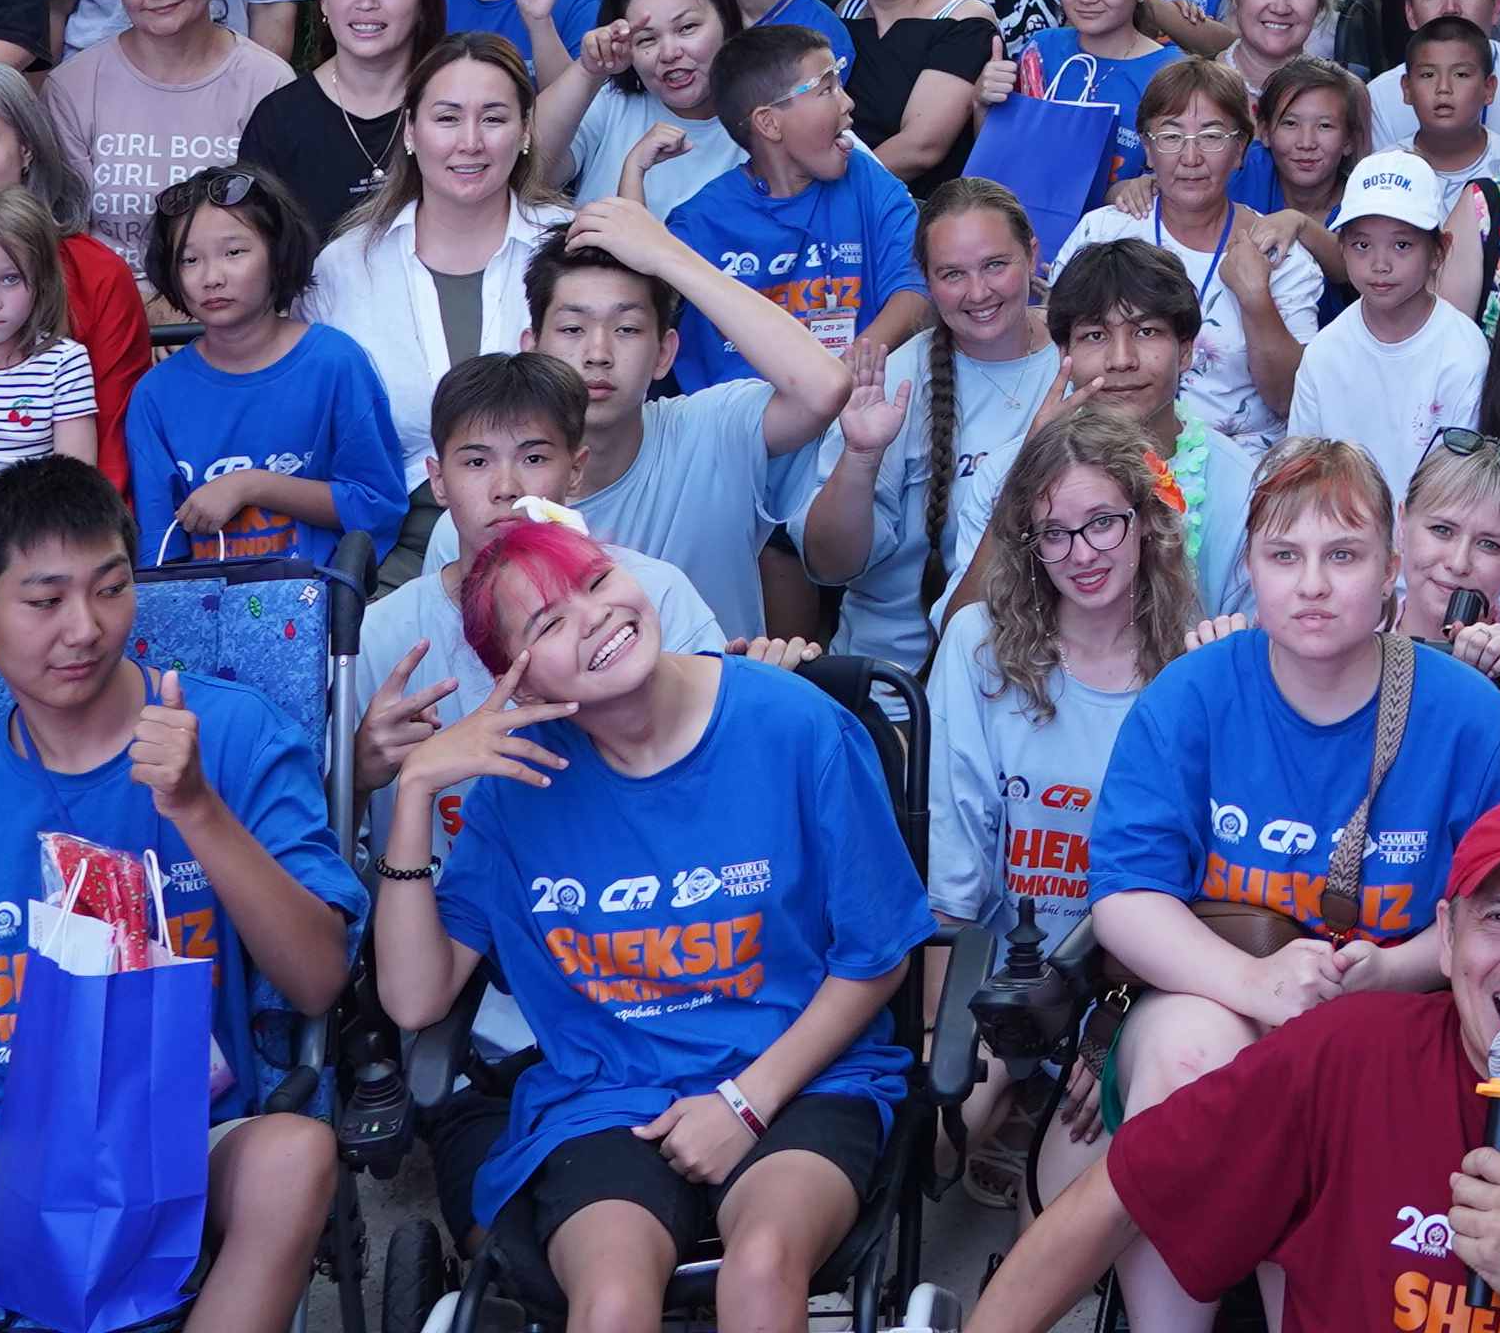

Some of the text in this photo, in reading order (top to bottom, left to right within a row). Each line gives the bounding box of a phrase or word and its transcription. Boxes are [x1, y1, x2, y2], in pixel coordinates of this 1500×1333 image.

[96, 133, 240, 158] GIRL BOSS
[94, 163, 159, 186] GIRL
[720, 252, 759, 276] 20
[1379, 832, 1427, 845] SAMRUK
[1384, 851, 1421, 865] TRUST
[720, 860, 770, 880] SAMRUK
[533, 877, 585, 913] 20
[726, 881, 766, 899] TRUST
[1204, 853, 1412, 931] SHEKIZ
[546, 911, 764, 981] SHEKSIZ
